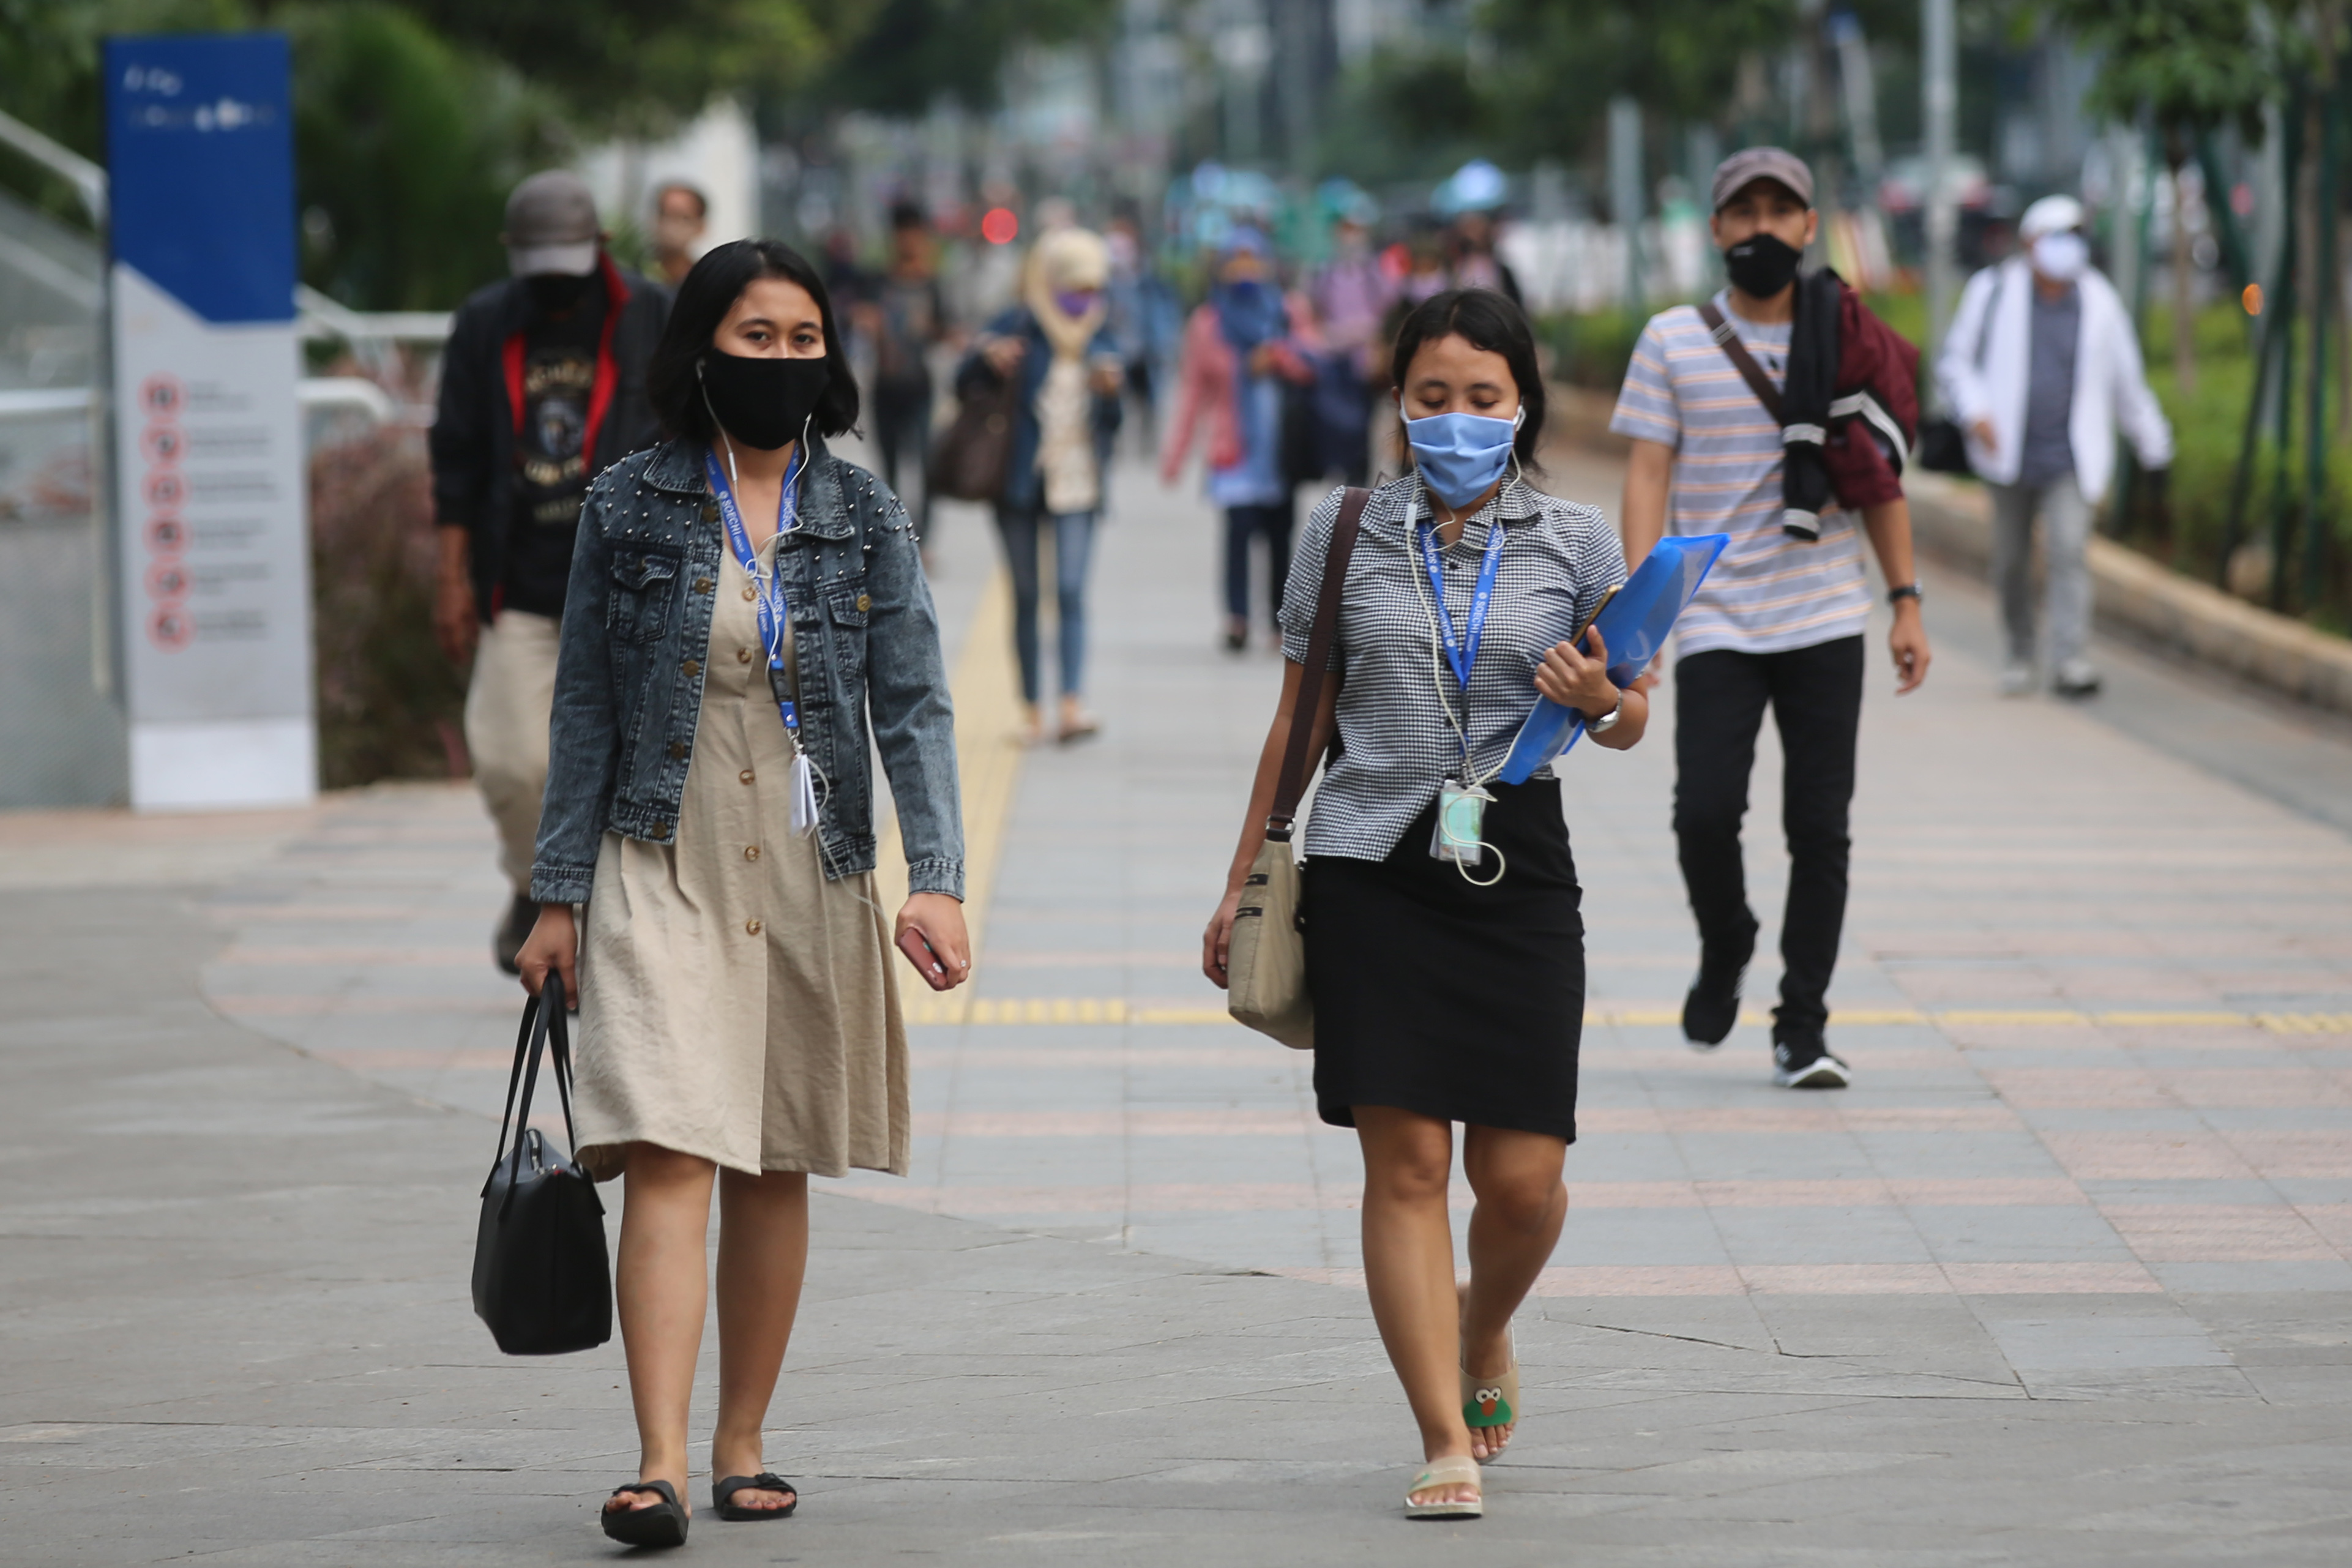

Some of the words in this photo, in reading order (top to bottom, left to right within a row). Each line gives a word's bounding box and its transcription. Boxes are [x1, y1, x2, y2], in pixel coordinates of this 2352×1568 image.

[722, 499, 742, 536] SOECHI
[1422, 533, 1437, 564] SOECHI
[1470, 600, 1486, 633] SOECHI
